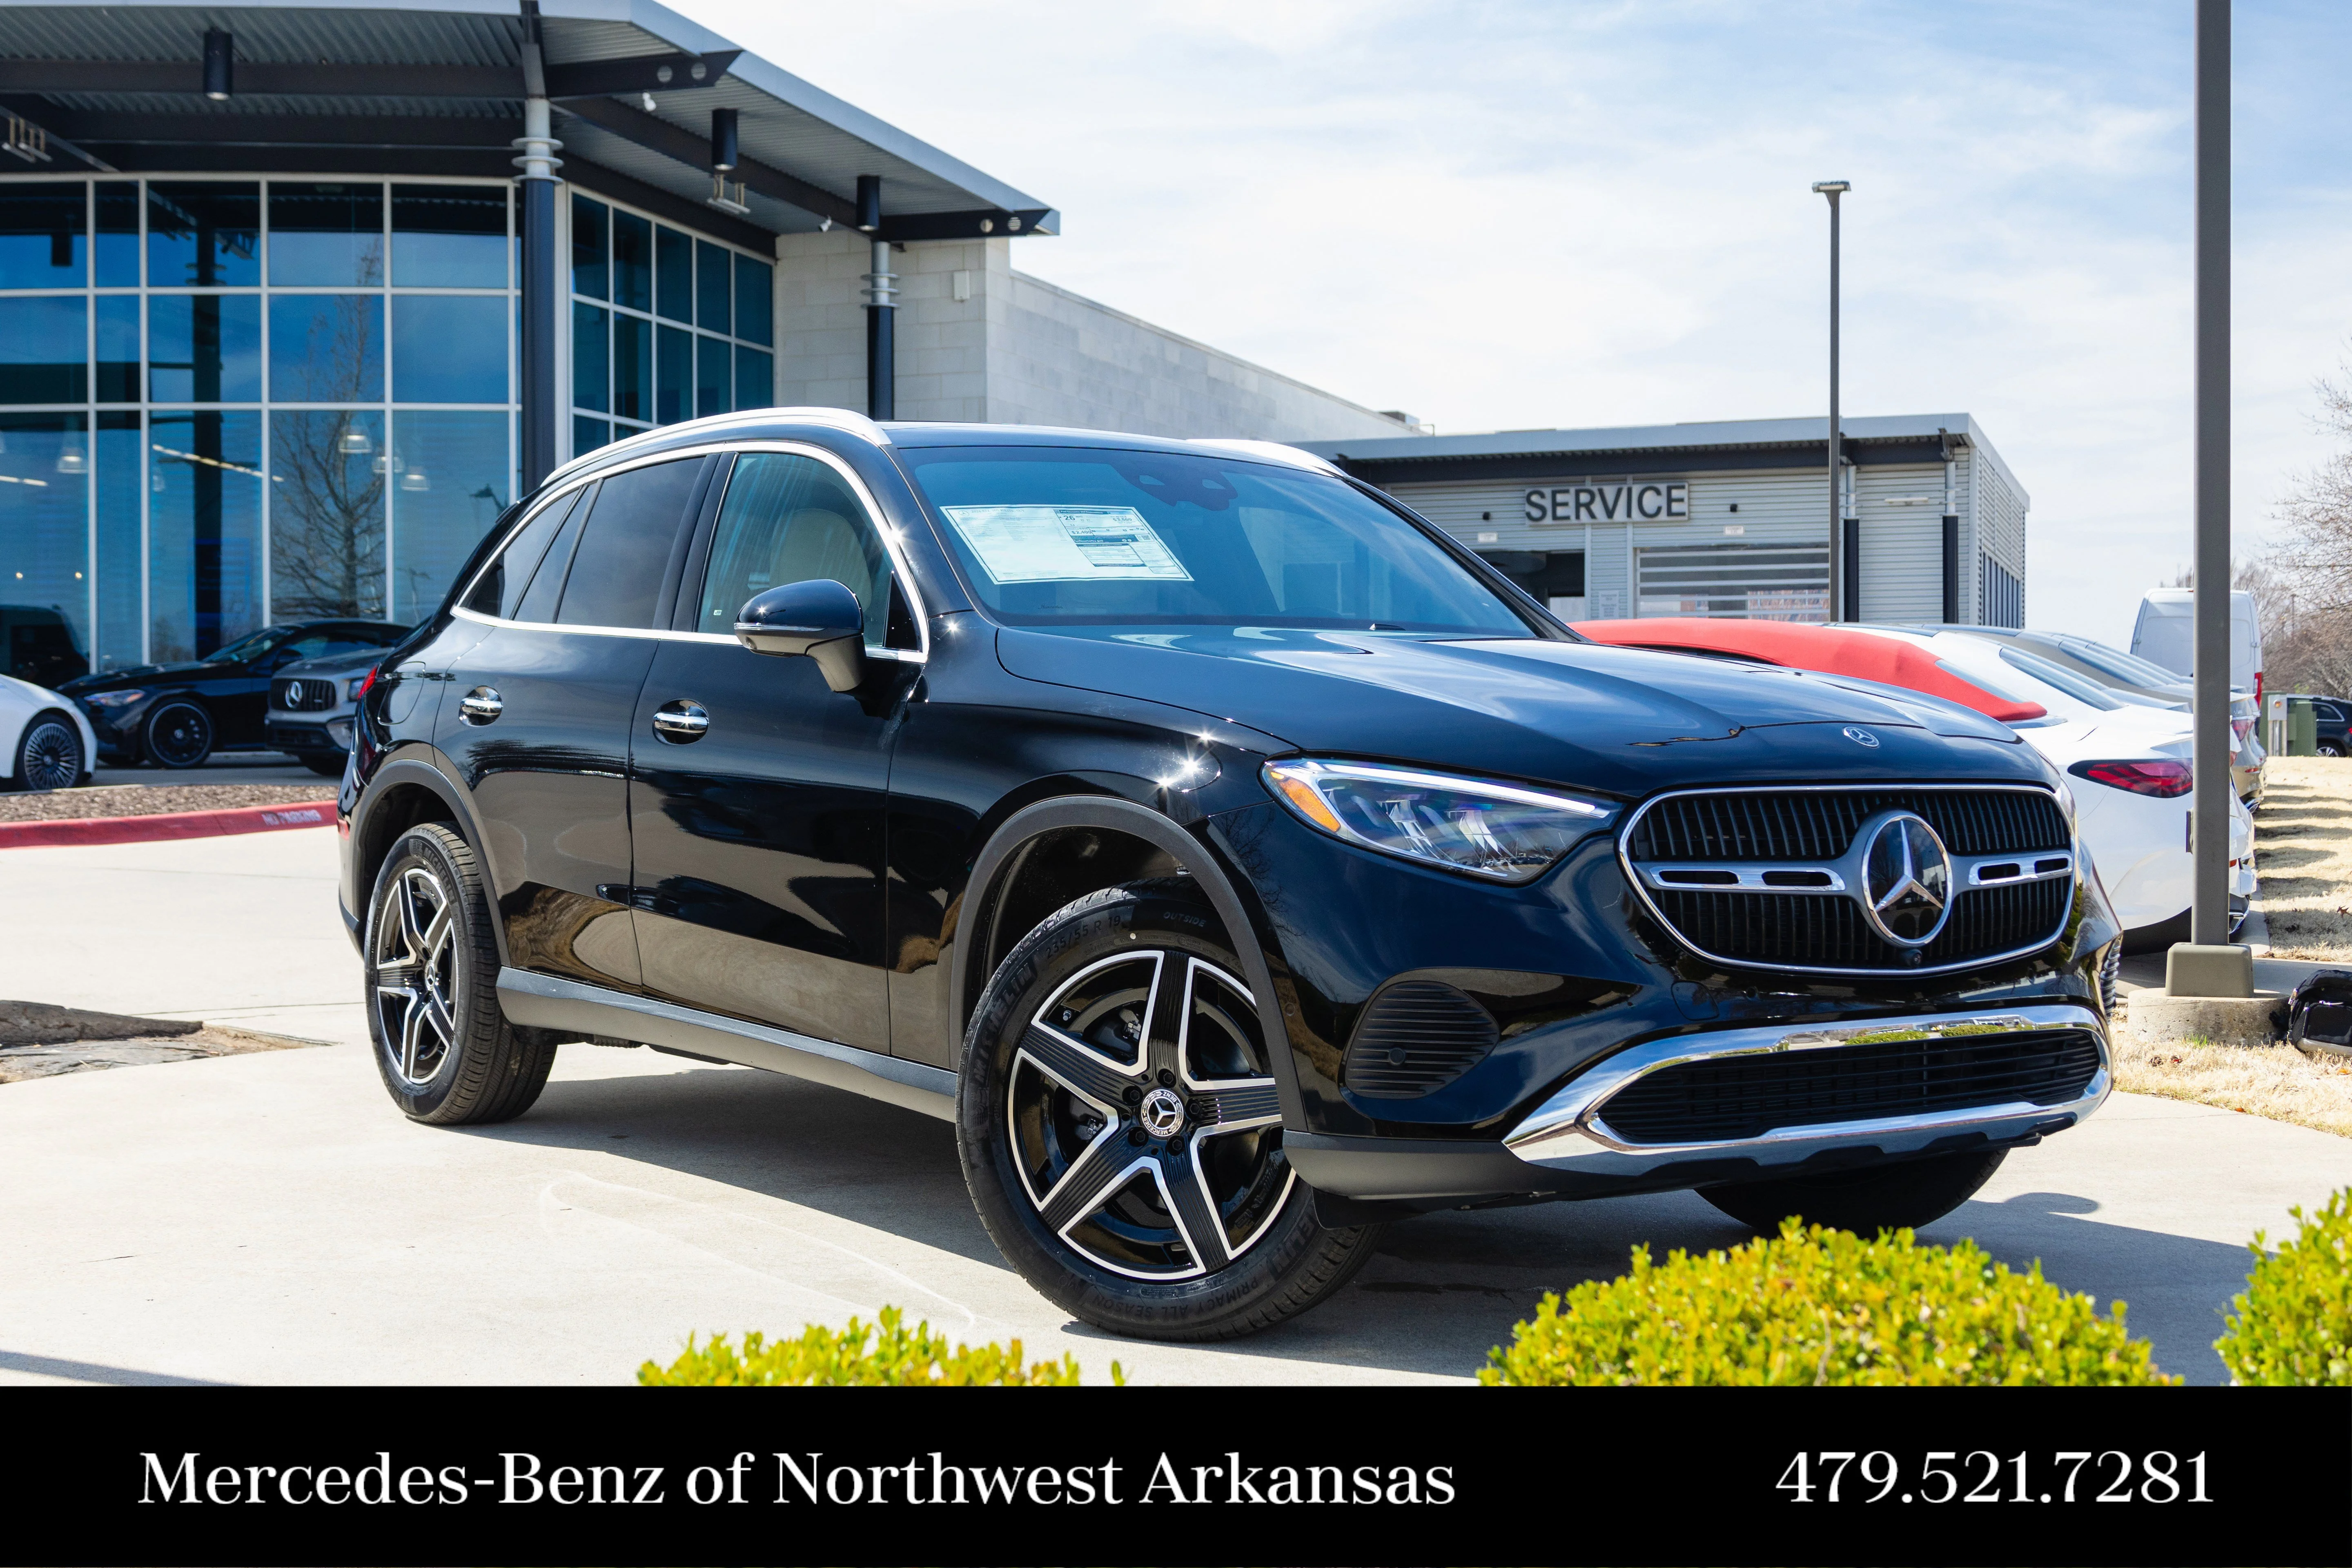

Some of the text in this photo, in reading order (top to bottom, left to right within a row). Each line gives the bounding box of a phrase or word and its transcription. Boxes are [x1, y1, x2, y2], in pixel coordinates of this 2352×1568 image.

[1525, 485, 1686, 522] SERVICE
[423, 847, 455, 899] MICHELIN
[1163, 911, 1207, 927] OUTSIDE
[1045, 915, 1121, 960] 235/55 R 19
[973, 962, 1032, 1084] MICHELIN
[1163, 1091, 1177, 1103] BENZ
[1143, 1116, 1168, 1135] MERCEDES
[1091, 1296, 1153, 1318] SEASON
[1196, 1276, 1259, 1314] PRIMACY
[1161, 1304, 1189, 1318] ALL
